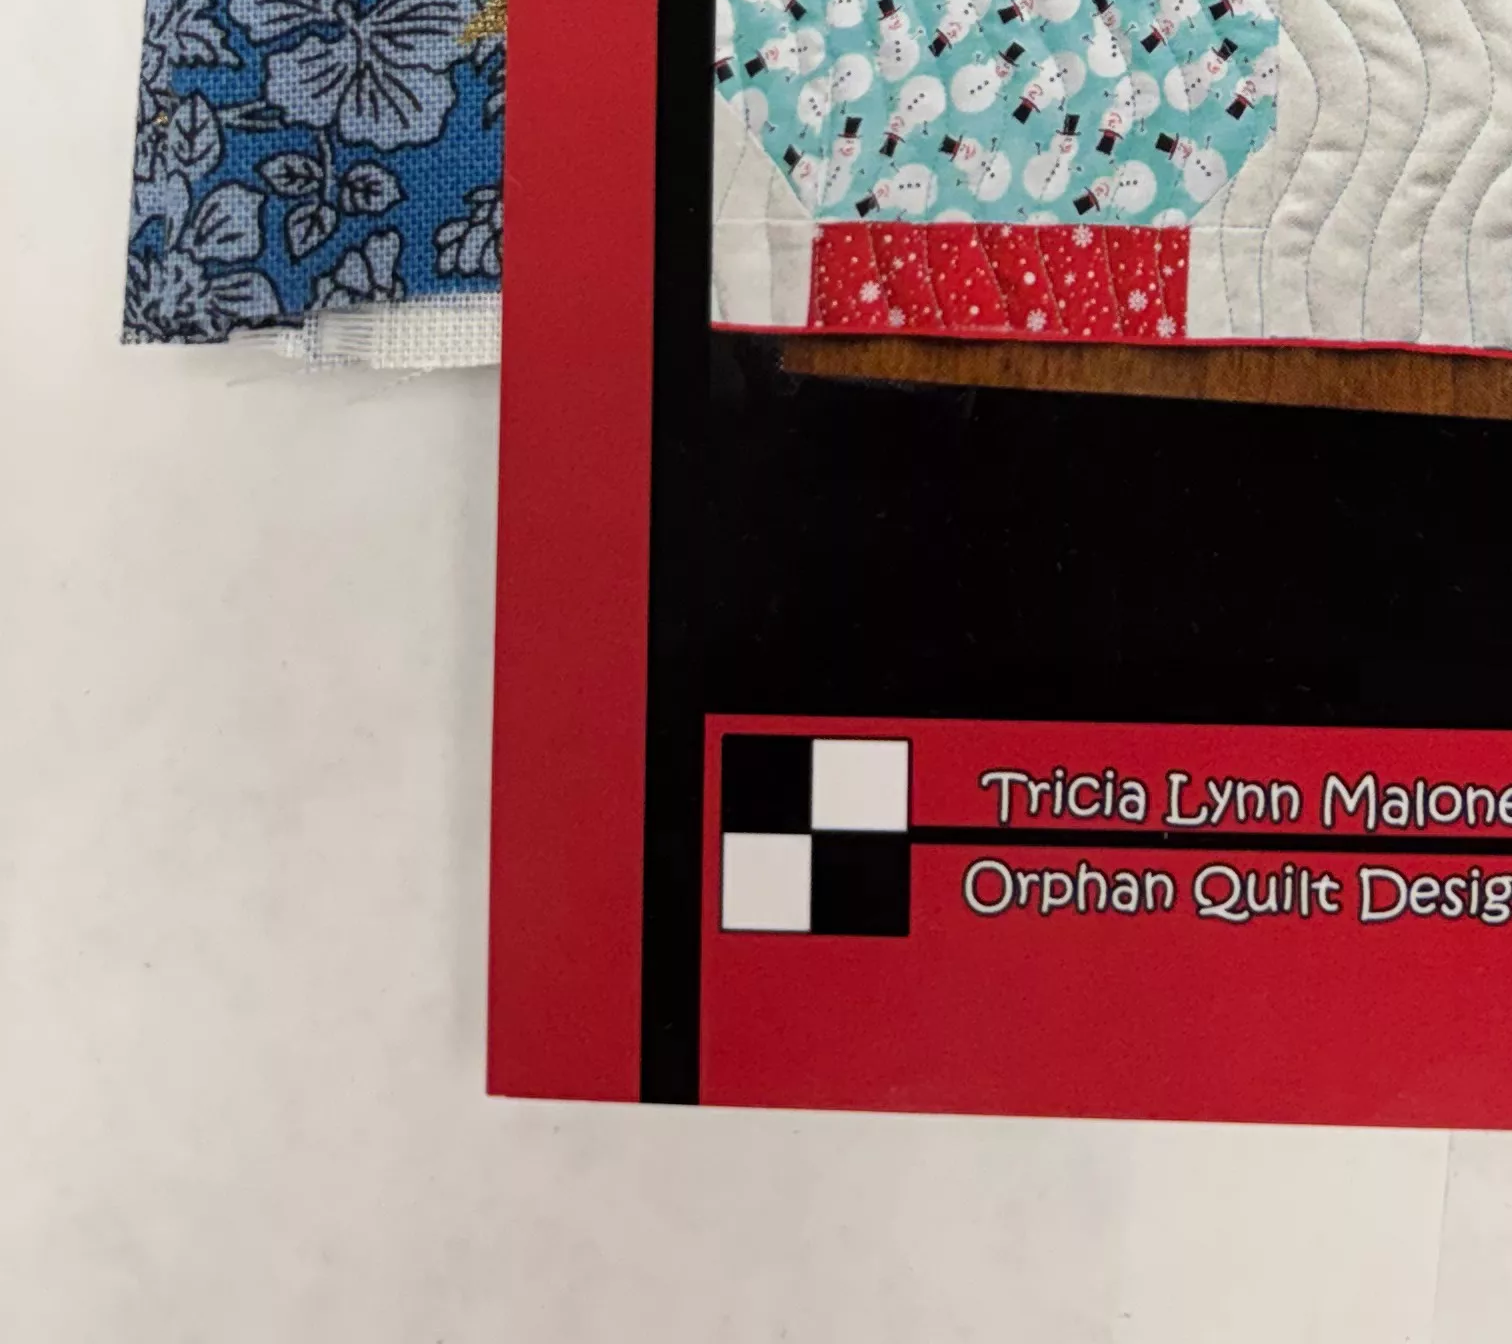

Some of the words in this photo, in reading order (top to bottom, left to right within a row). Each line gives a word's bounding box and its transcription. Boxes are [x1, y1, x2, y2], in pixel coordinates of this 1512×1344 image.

[981, 769, 1148, 824] Tricia
[1166, 773, 1301, 826] Lynn
[963, 859, 1176, 915] Orphan
[1193, 863, 1343, 923] Quilt
